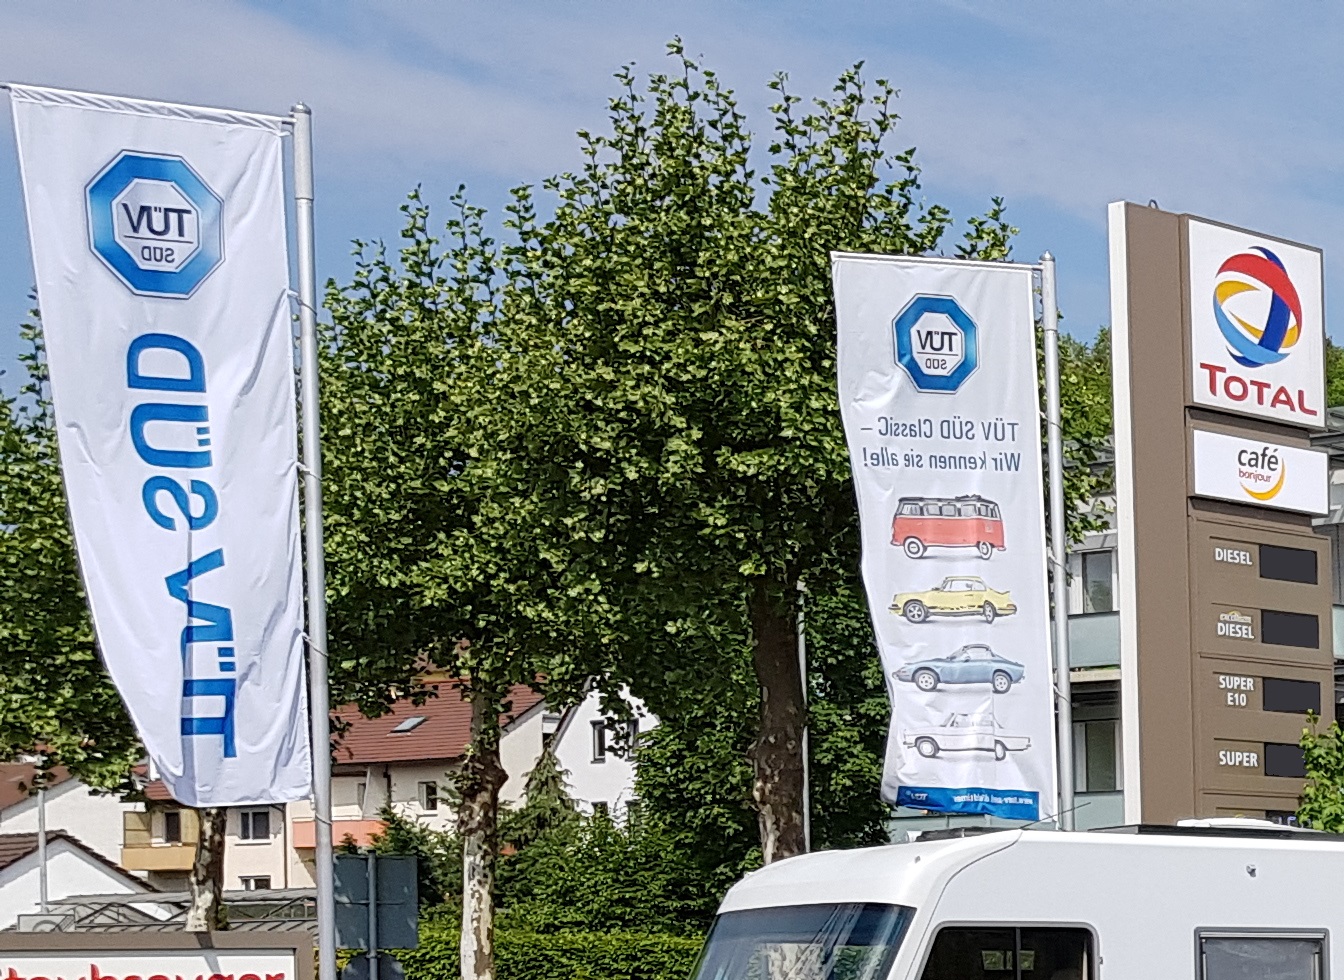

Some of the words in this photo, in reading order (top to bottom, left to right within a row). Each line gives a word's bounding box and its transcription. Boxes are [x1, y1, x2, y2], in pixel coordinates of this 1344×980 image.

[1200, 362, 1317, 416] TOTAL
[1238, 446, 1279, 471] café
[1238, 467, 1272, 483] bonjour
[1215, 547, 1253, 565] DIESEL
[1217, 622, 1255, 639] DIESEL
[1219, 675, 1254, 690] SUPER
[1227, 692, 1247, 706] E10
[1219, 750, 1258, 767] SUPER
